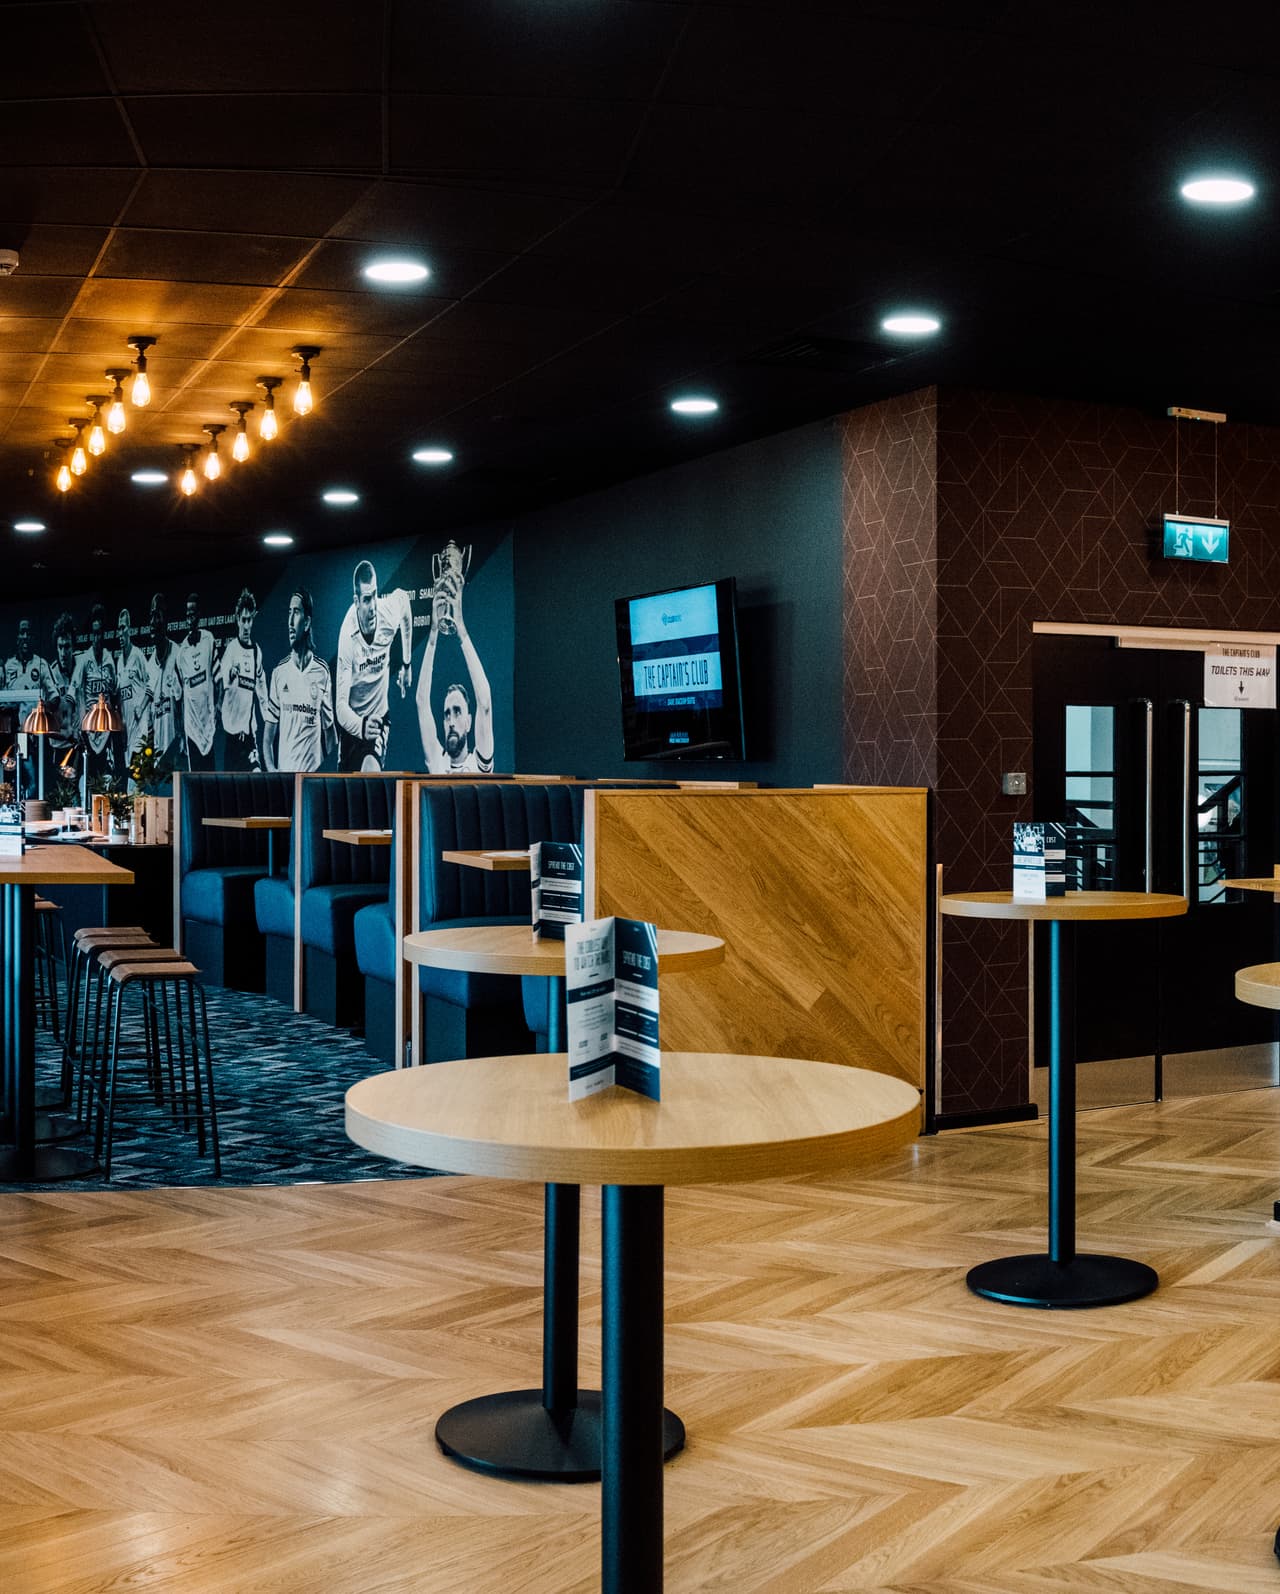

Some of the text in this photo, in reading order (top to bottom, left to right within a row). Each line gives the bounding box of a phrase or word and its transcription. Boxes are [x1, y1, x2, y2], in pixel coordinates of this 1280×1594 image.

[644, 659, 709, 690] THE CAPTAIN'S CLUB
[1211, 665, 1270, 677] TOILETS THIS WAY
